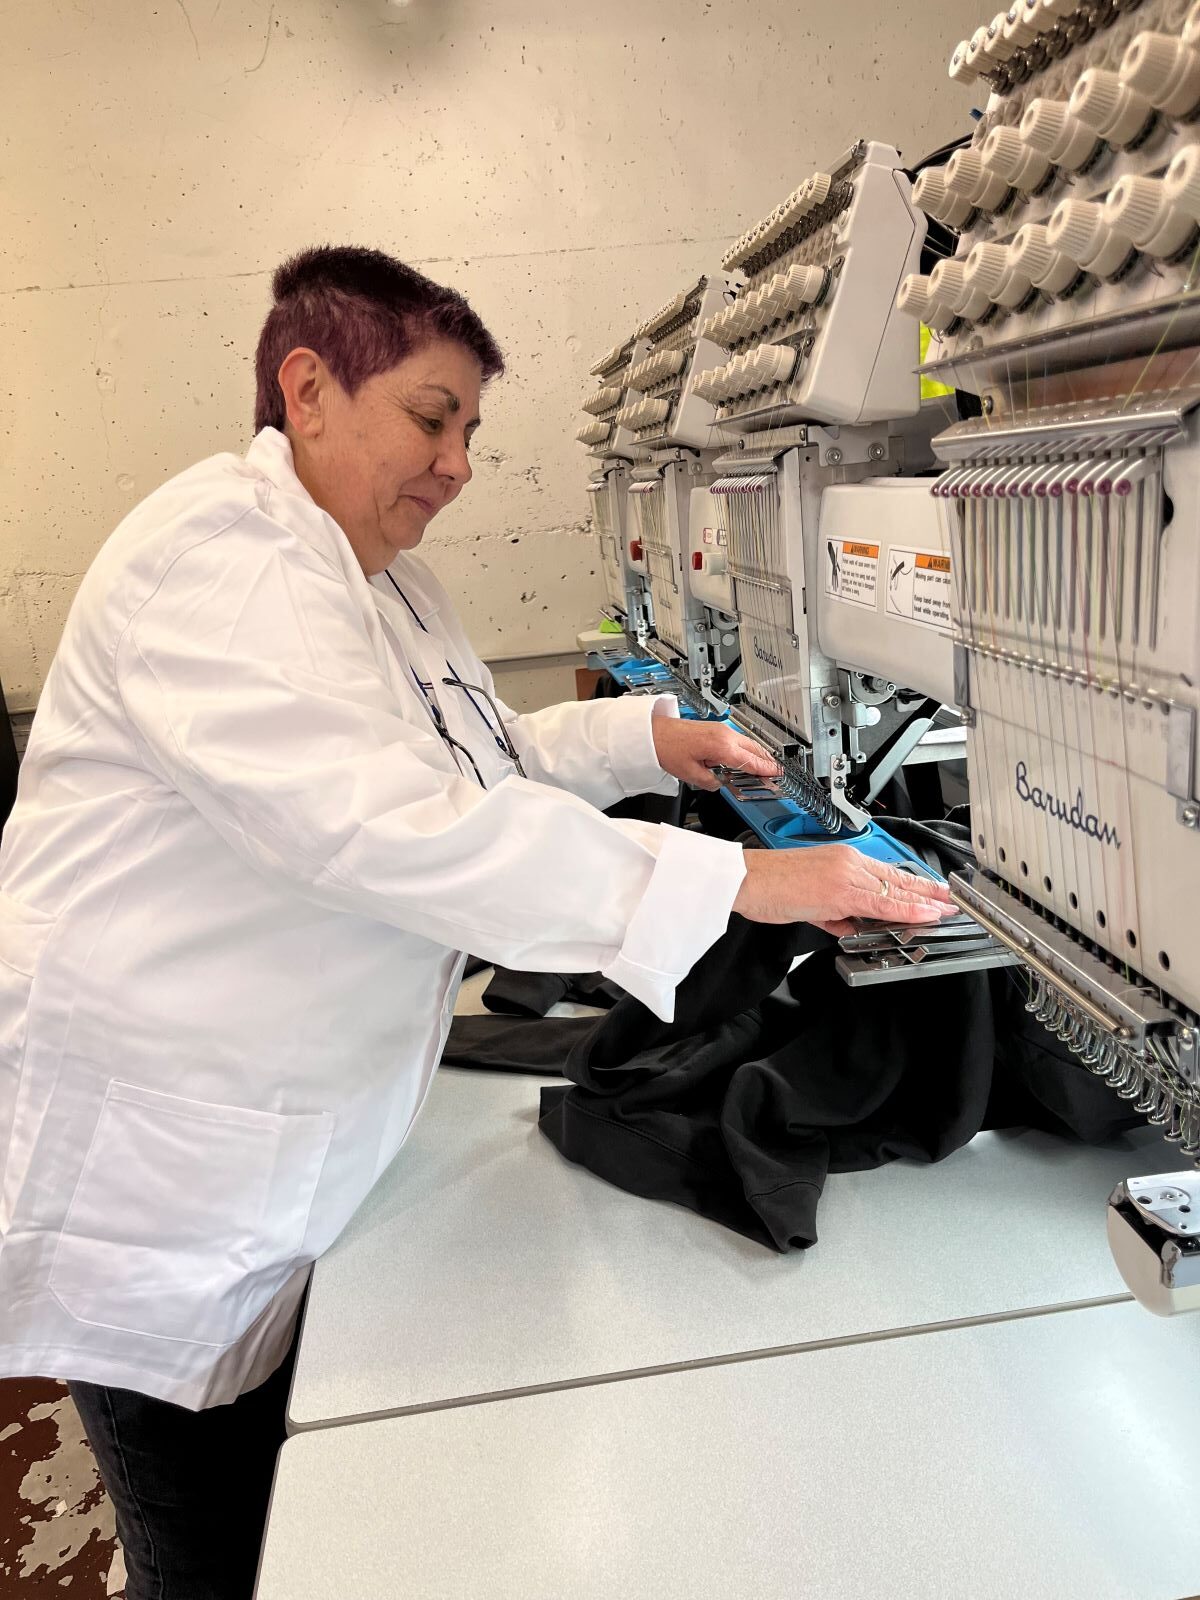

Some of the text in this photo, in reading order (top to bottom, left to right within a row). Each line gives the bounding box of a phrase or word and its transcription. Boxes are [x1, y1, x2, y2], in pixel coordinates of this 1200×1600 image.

[852, 546, 870, 554] WARNING
[932, 558, 950, 570] WARN
[1016, 761, 1121, 850] Barudan
